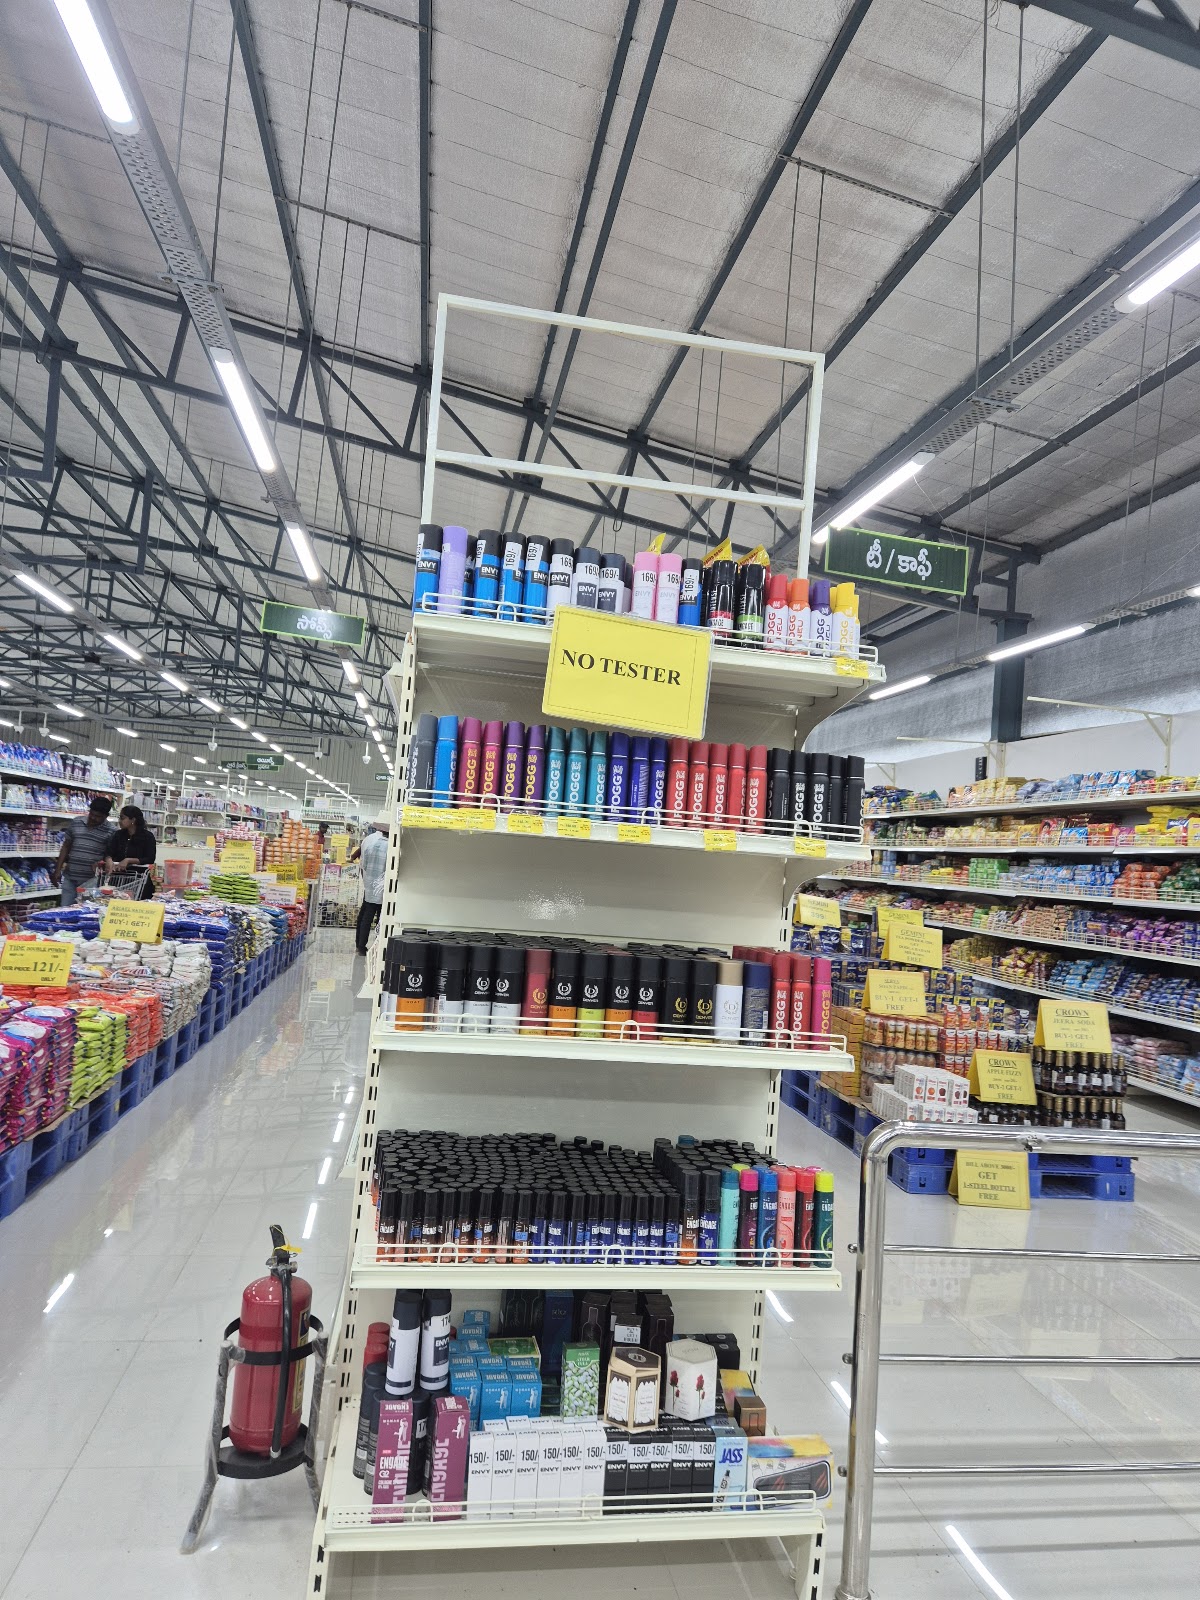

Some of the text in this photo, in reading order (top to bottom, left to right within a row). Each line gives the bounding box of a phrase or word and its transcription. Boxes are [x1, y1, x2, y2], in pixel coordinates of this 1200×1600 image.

[551, 574, 569, 582] ENVY
[578, 585, 596, 593] ENVY
[766, 612, 776, 644] FOGG
[788, 614, 796, 646] FOGG
[816, 618, 825, 649] FOGG
[560, 648, 681, 686] NO TESTER
[464, 759, 476, 798] FOGG
[504, 763, 516, 802] FOGG
[525, 765, 536, 803] FOGG
[548, 769, 560, 808] FOGG
[568, 771, 580, 811] FOGG
[595, 774, 605, 812] FOGG
[611, 775, 622, 814] FOGG
[674, 780, 685, 818] FOGG
[693, 782, 704, 821] FOGG
[714, 784, 725, 822] FOGG
[748, 788, 759, 826] FOGG
[813, 794, 824, 831] FOGG
[114, 929, 138, 938] FREE
[900, 929, 926, 938] GEMINI
[32, 961, 64, 972] 121/-
[1055, 1008, 1089, 1016] CROWN
[793, 1001, 803, 1040] FOGG
[988, 1058, 1017, 1067] CROWN
[978, 1171, 998, 1180] GET
[990, 1184, 1016, 1192] BOTTLE
[978, 1192, 1000, 1200] FREE
[699, 1218, 717, 1229] ENGAGE
[543, 1447, 562, 1460] 150/-
[563, 1445, 582, 1458] 150/-
[586, 1446, 606, 1458] 150/-
[608, 1443, 627, 1455] 150/-
[633, 1445, 651, 1457] 150/-
[652, 1445, 671, 1456] 150/-
[674, 1443, 693, 1454] 150/-
[469, 1451, 490, 1464] 150/-
[495, 1449, 515, 1462] 150/-
[718, 1447, 744, 1464] JASS
